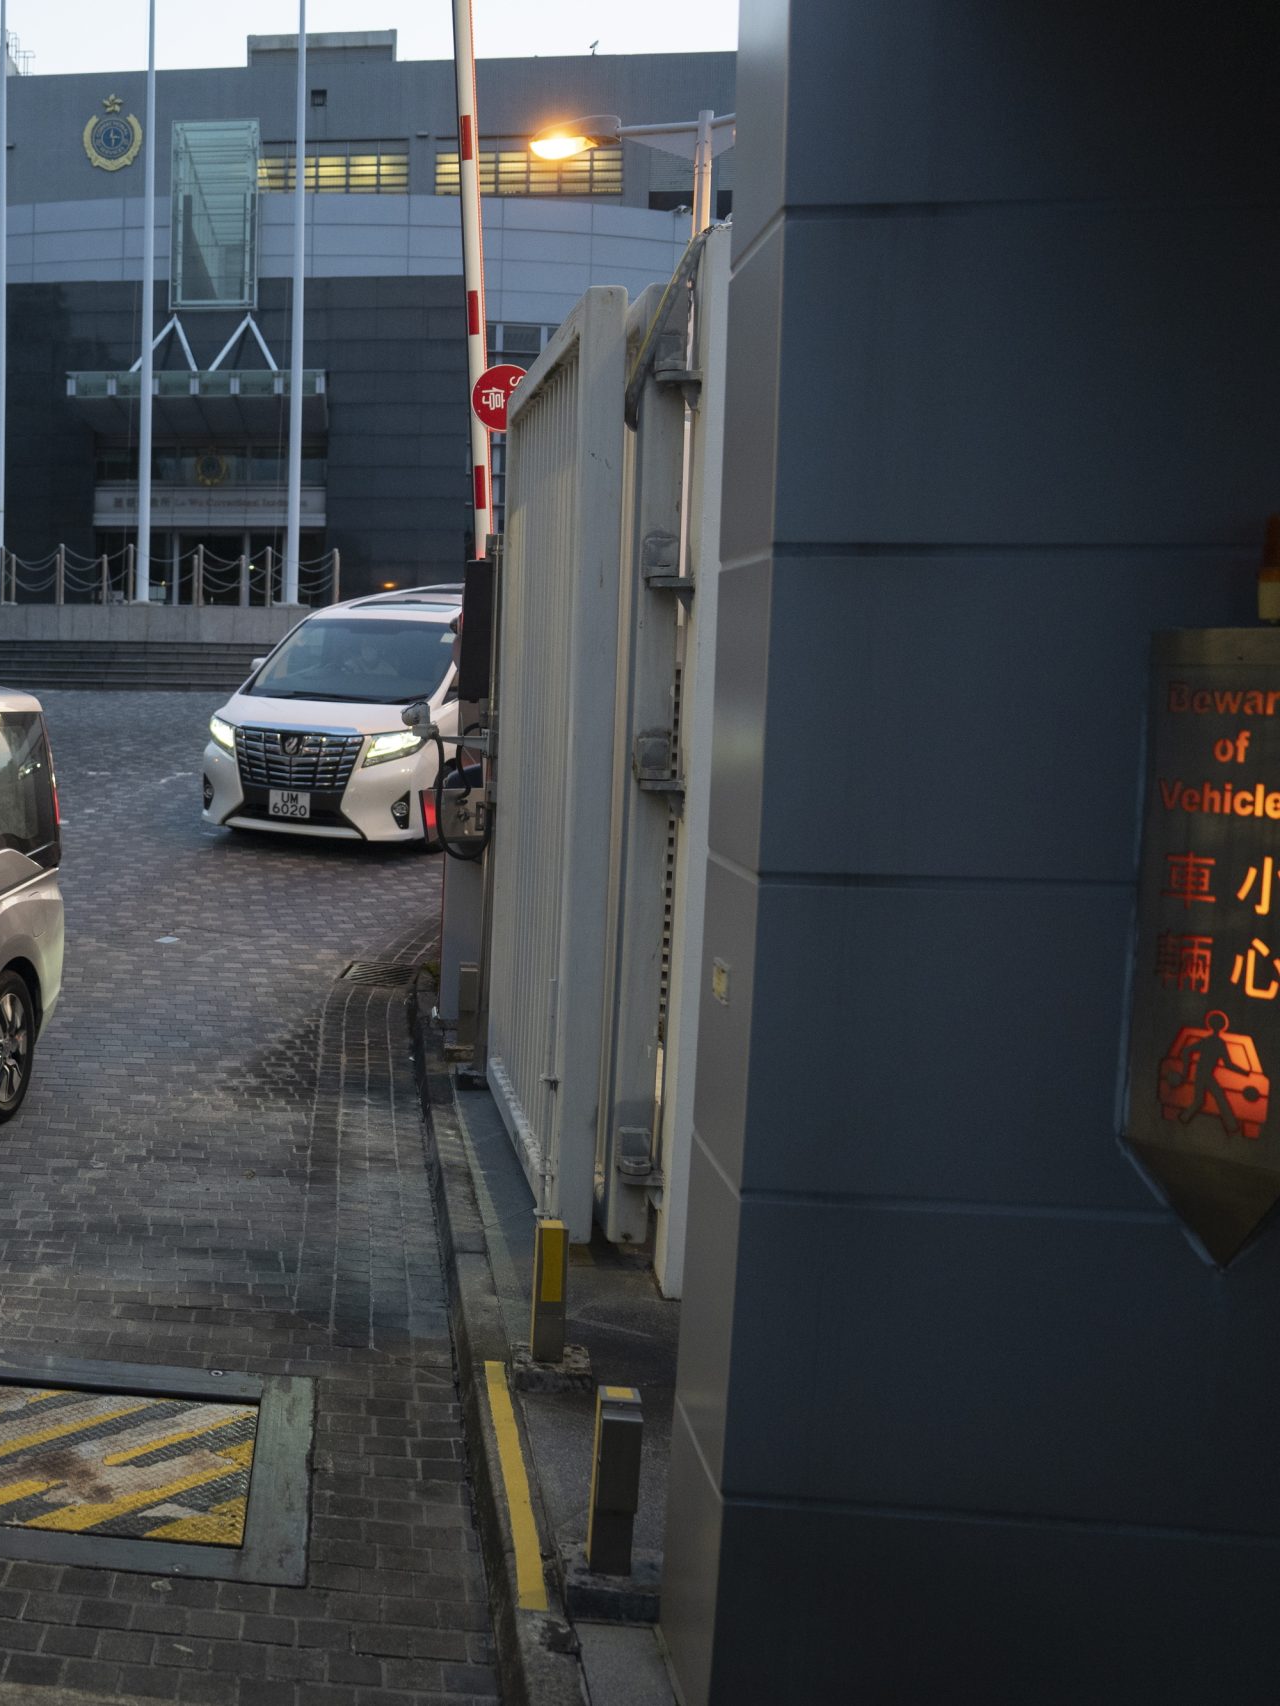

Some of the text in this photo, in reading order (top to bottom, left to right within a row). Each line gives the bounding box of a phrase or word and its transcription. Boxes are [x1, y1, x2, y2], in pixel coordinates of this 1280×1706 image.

[481, 386, 505, 411] 停
[1214, 729, 1251, 764] of
[272, 802, 307, 817] 6020
[281, 791, 299, 805] UM
[1158, 777, 1280, 820] Vehicle
